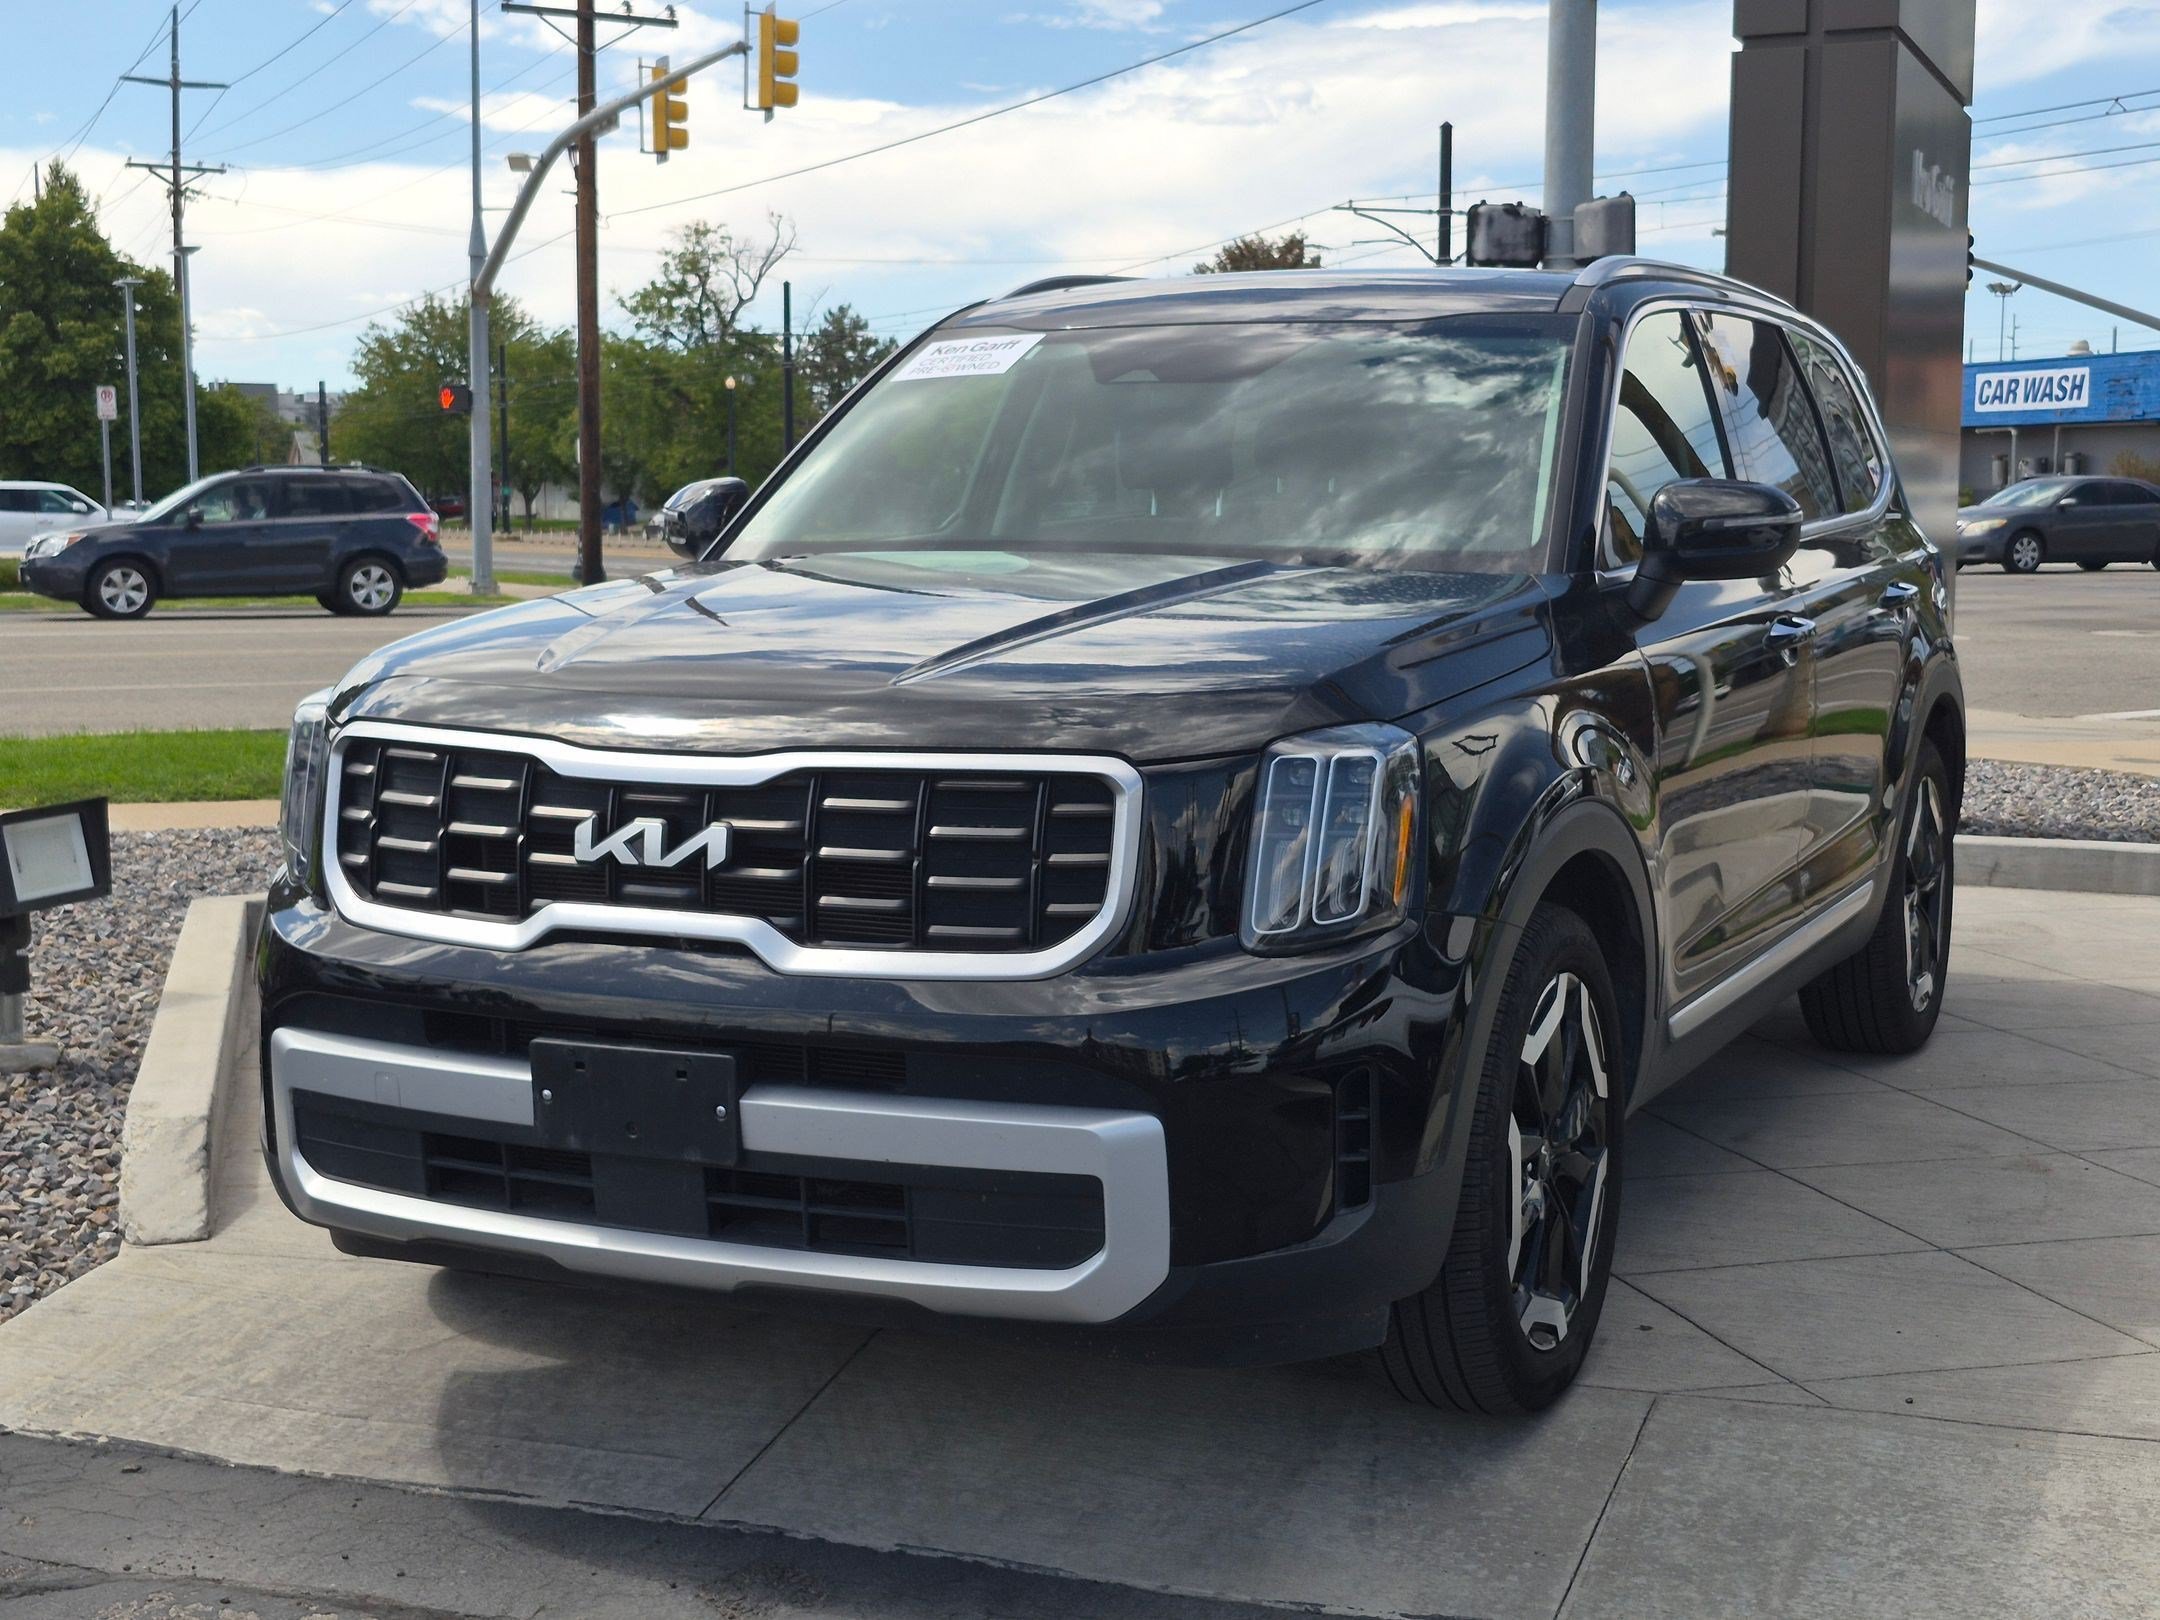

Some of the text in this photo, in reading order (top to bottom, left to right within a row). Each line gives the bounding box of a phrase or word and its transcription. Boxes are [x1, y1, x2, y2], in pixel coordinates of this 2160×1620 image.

[919, 353, 993, 366] CERTIFIED
[931, 344, 969, 356] Ken
[1978, 374, 2086, 405] CAR WASH
[574, 814, 732, 871] KIA
